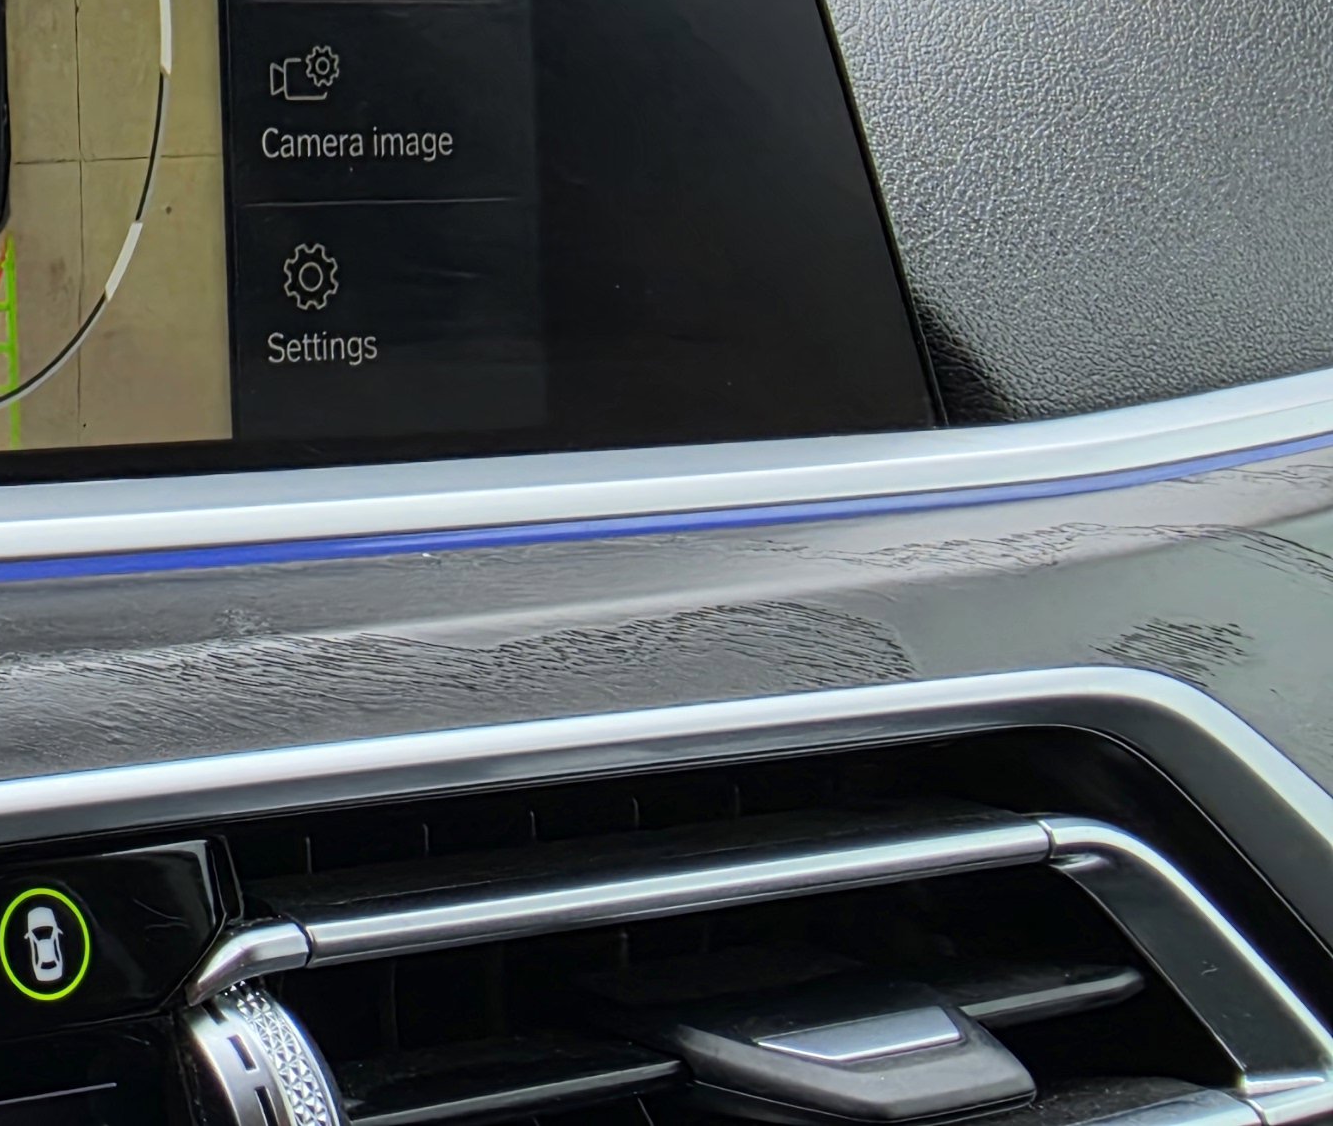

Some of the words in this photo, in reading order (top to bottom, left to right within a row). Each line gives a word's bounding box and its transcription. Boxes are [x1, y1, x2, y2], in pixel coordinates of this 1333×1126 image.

[261, 127, 364, 158] Camera
[373, 126, 453, 162] image
[268, 331, 378, 366] Settings
